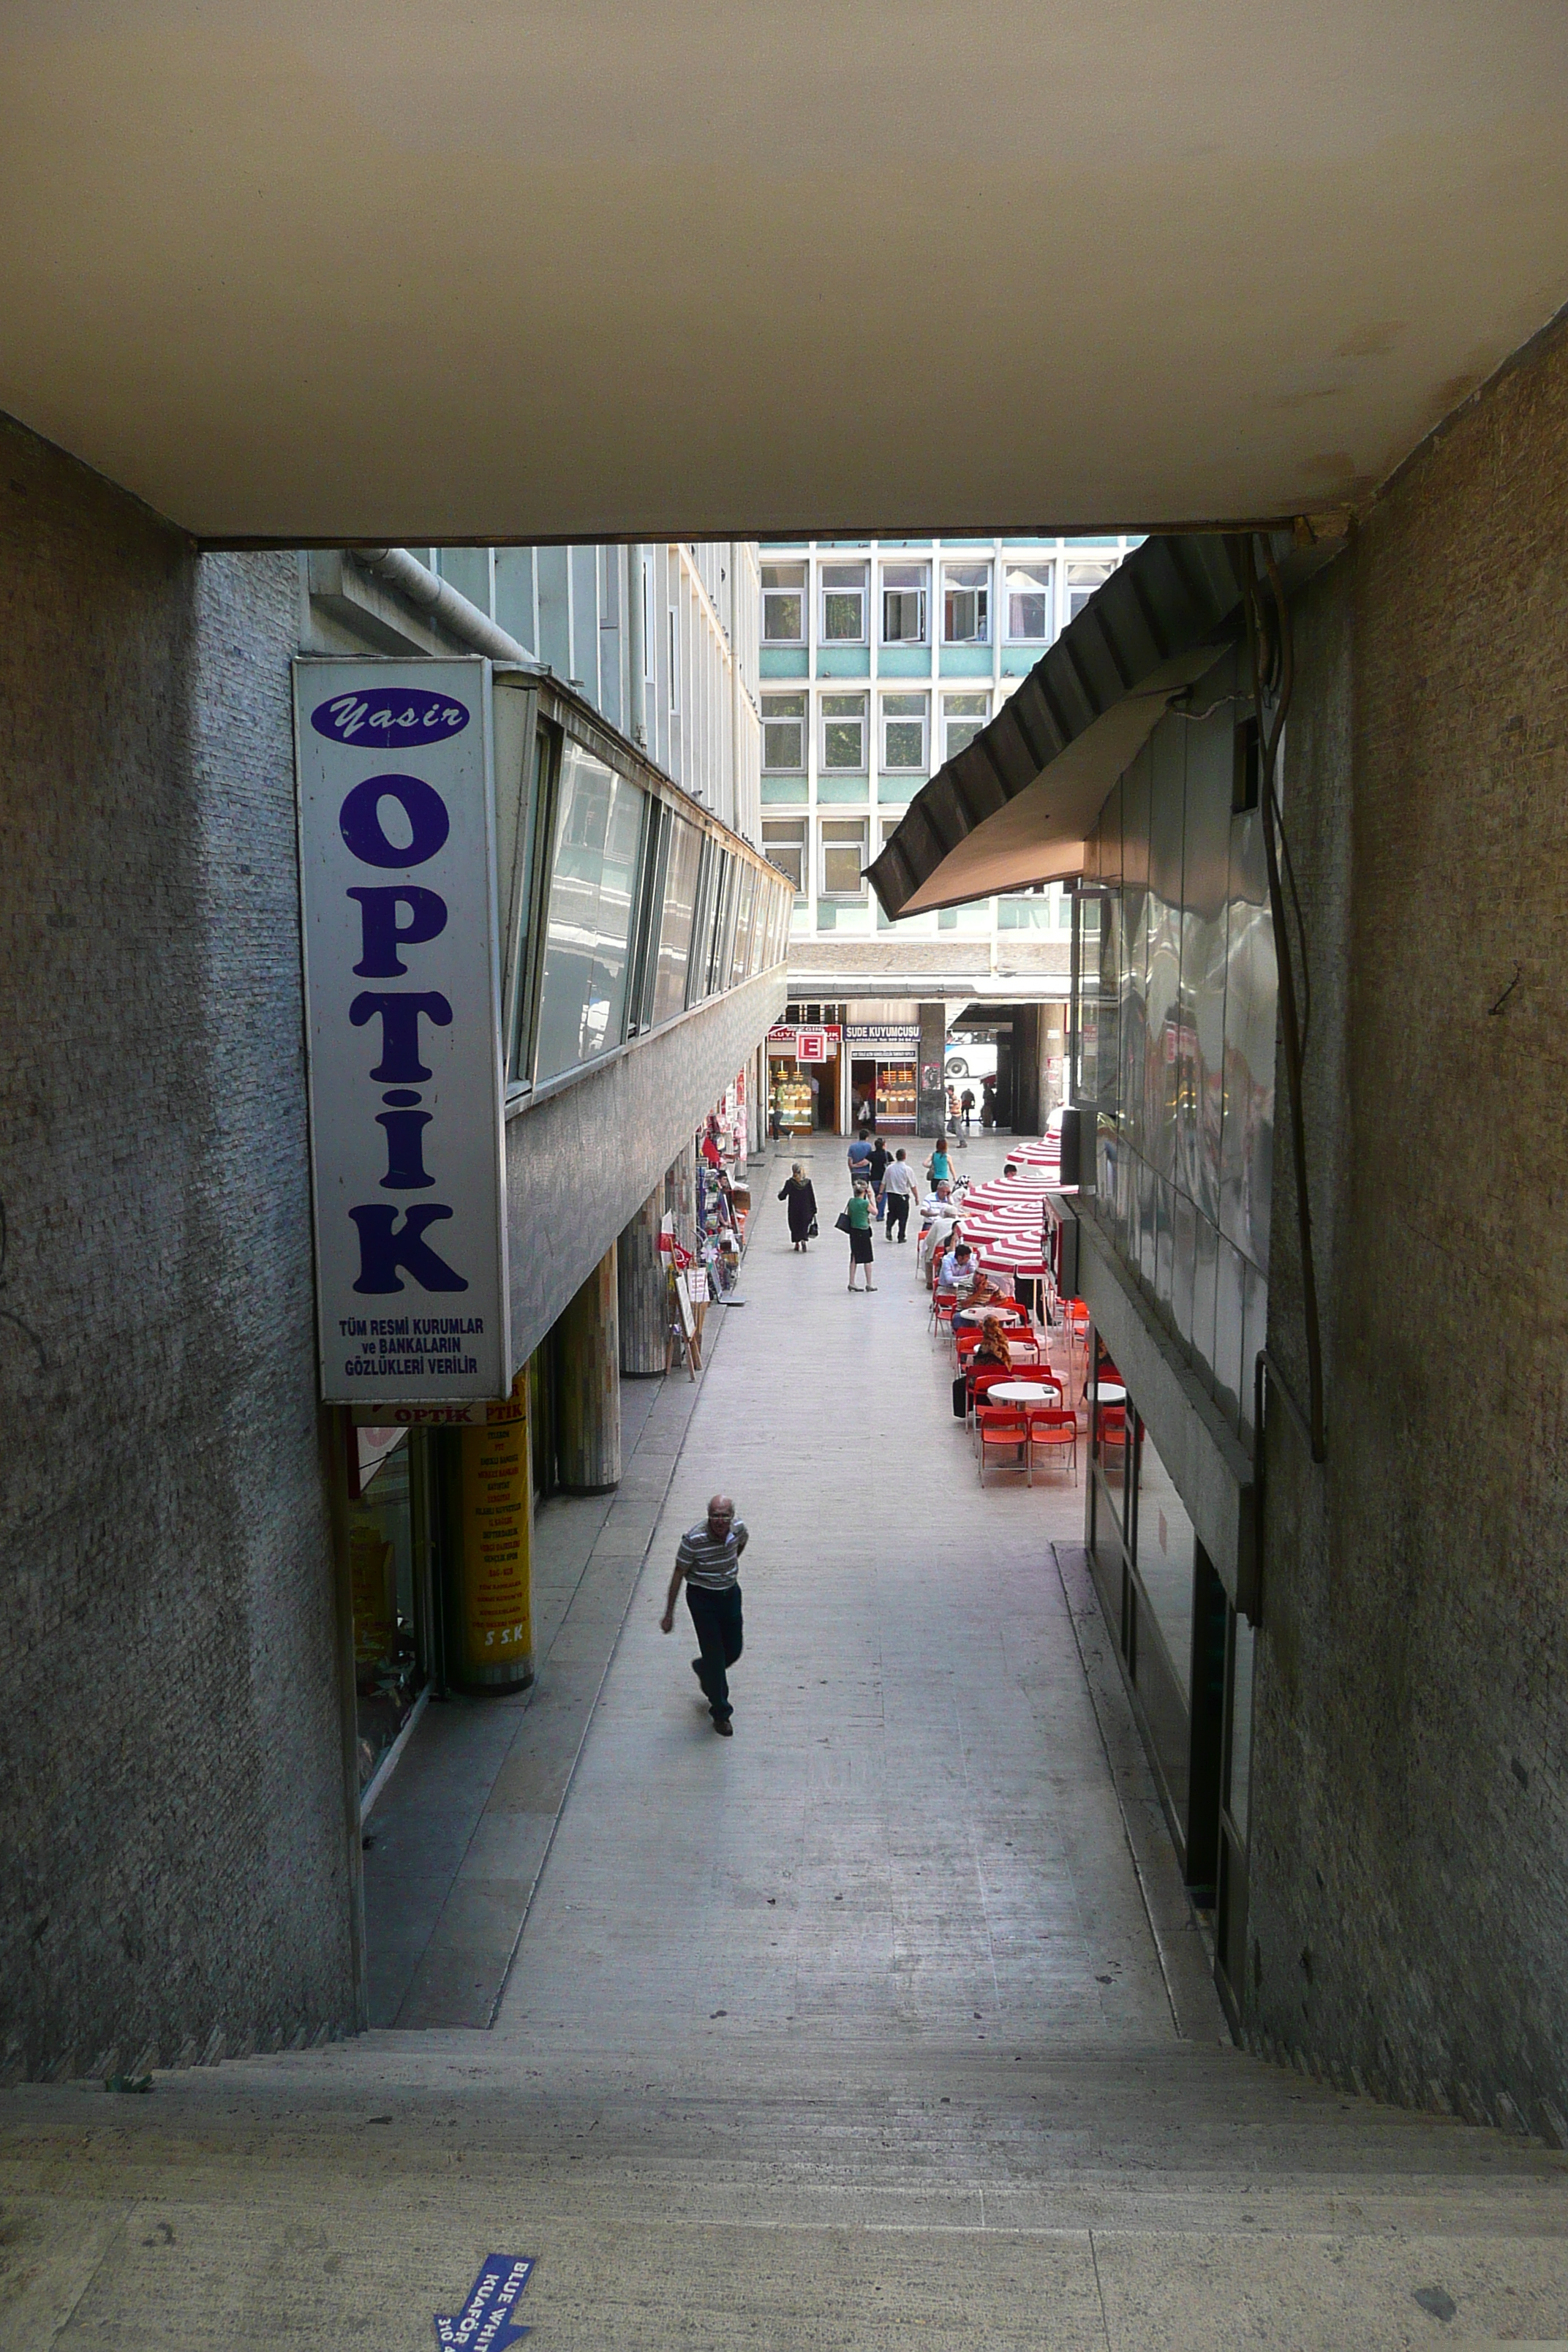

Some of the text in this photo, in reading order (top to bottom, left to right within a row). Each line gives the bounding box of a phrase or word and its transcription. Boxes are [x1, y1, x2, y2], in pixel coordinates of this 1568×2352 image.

[330, 696, 464, 738] Yasir
[339, 773, 471, 1294] OPTİK
[846, 1026, 919, 1038] SUDE KUYUMCUSU
[804, 1039, 818, 1055] E
[339, 1317, 483, 1335] TÜM RESMİ KURUMLAR
[361, 1337, 461, 1354] ve BANKALARIN
[345, 1355, 478, 1376] GÖZLÜKLERİ VERİLİR
[394, 1406, 474, 1422] OPTİK
[486, 1403, 523, 1420] PTİK
[453, 2274, 500, 2343] KUAFÖR
[474, 2262, 529, 2352] BLUE WHIT
[438, 2318, 453, 2341] 310
